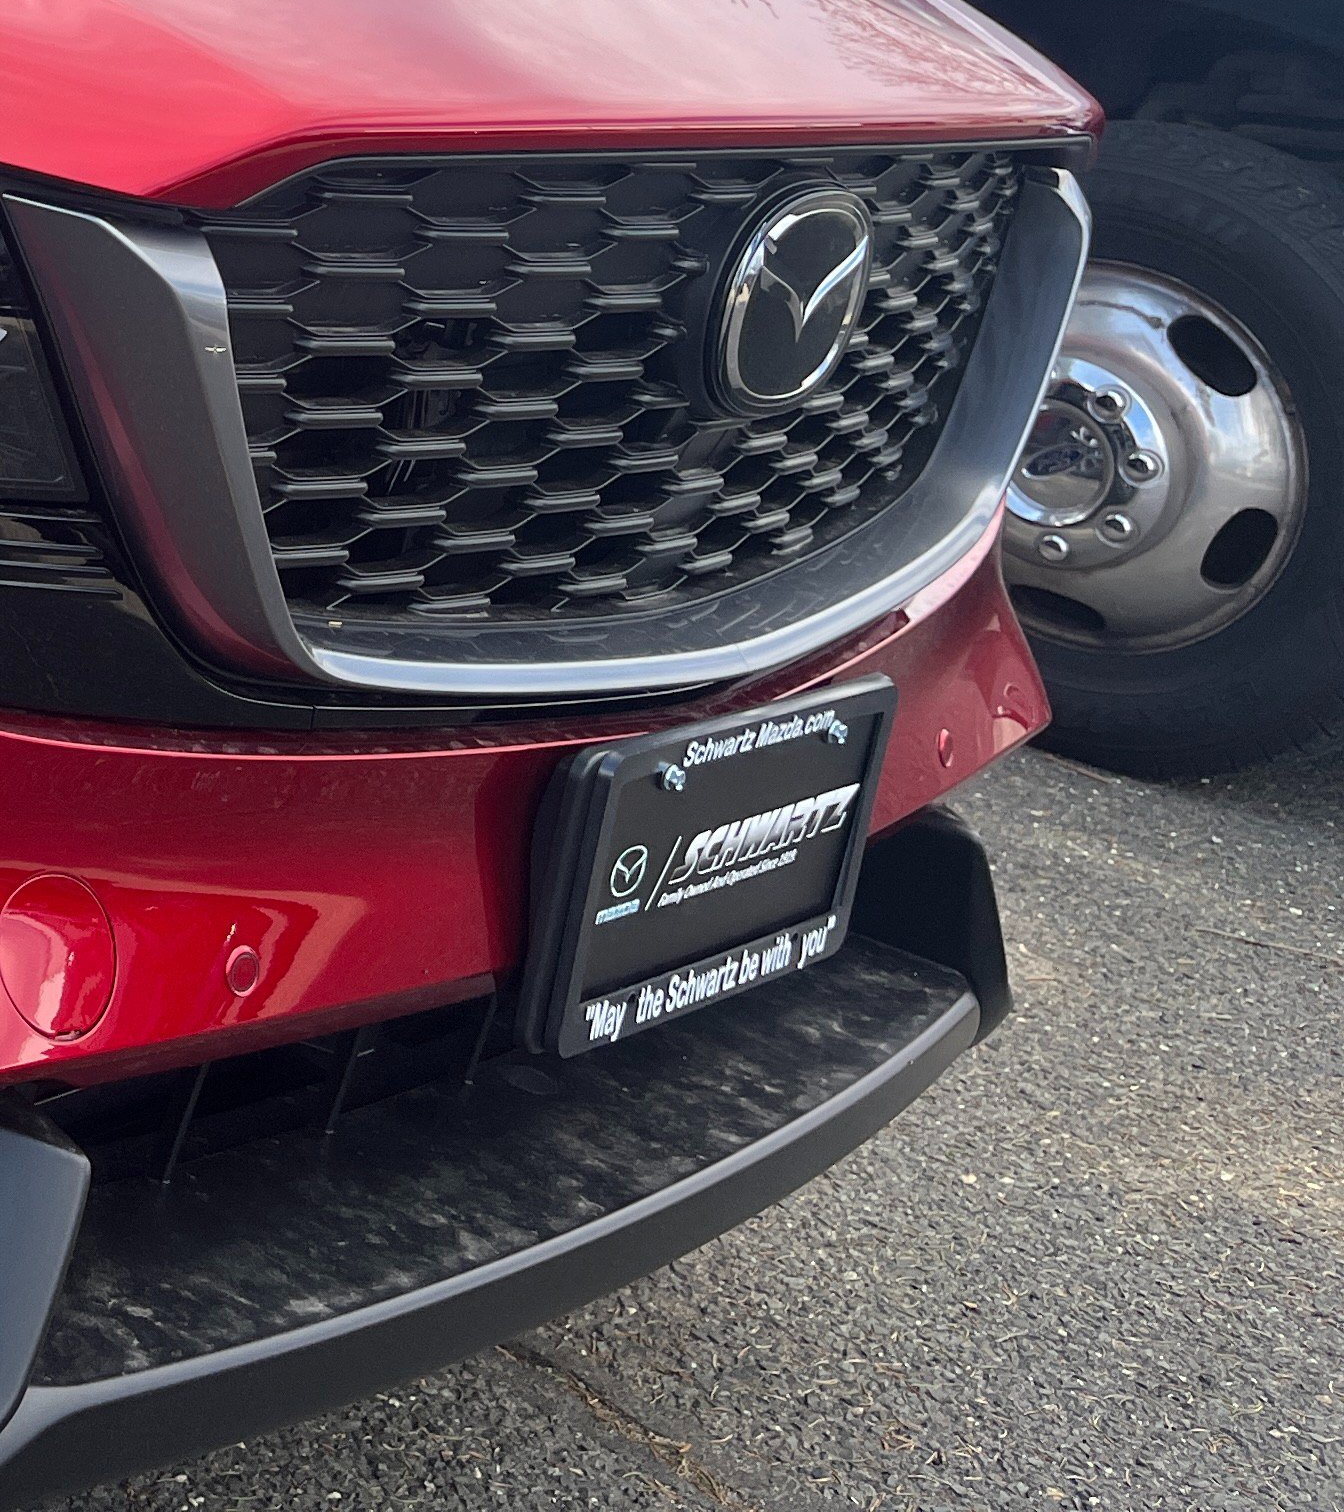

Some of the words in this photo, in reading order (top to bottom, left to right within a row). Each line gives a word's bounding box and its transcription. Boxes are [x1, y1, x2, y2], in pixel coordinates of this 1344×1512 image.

[683, 727, 757, 768] Schwartz
[667, 783, 861, 885] SCHWARTZ
[636, 984, 664, 1024] the
[665, 956, 739, 1013] Schwartz
[738, 949, 759, 985] be
[760, 932, 792, 977] with
